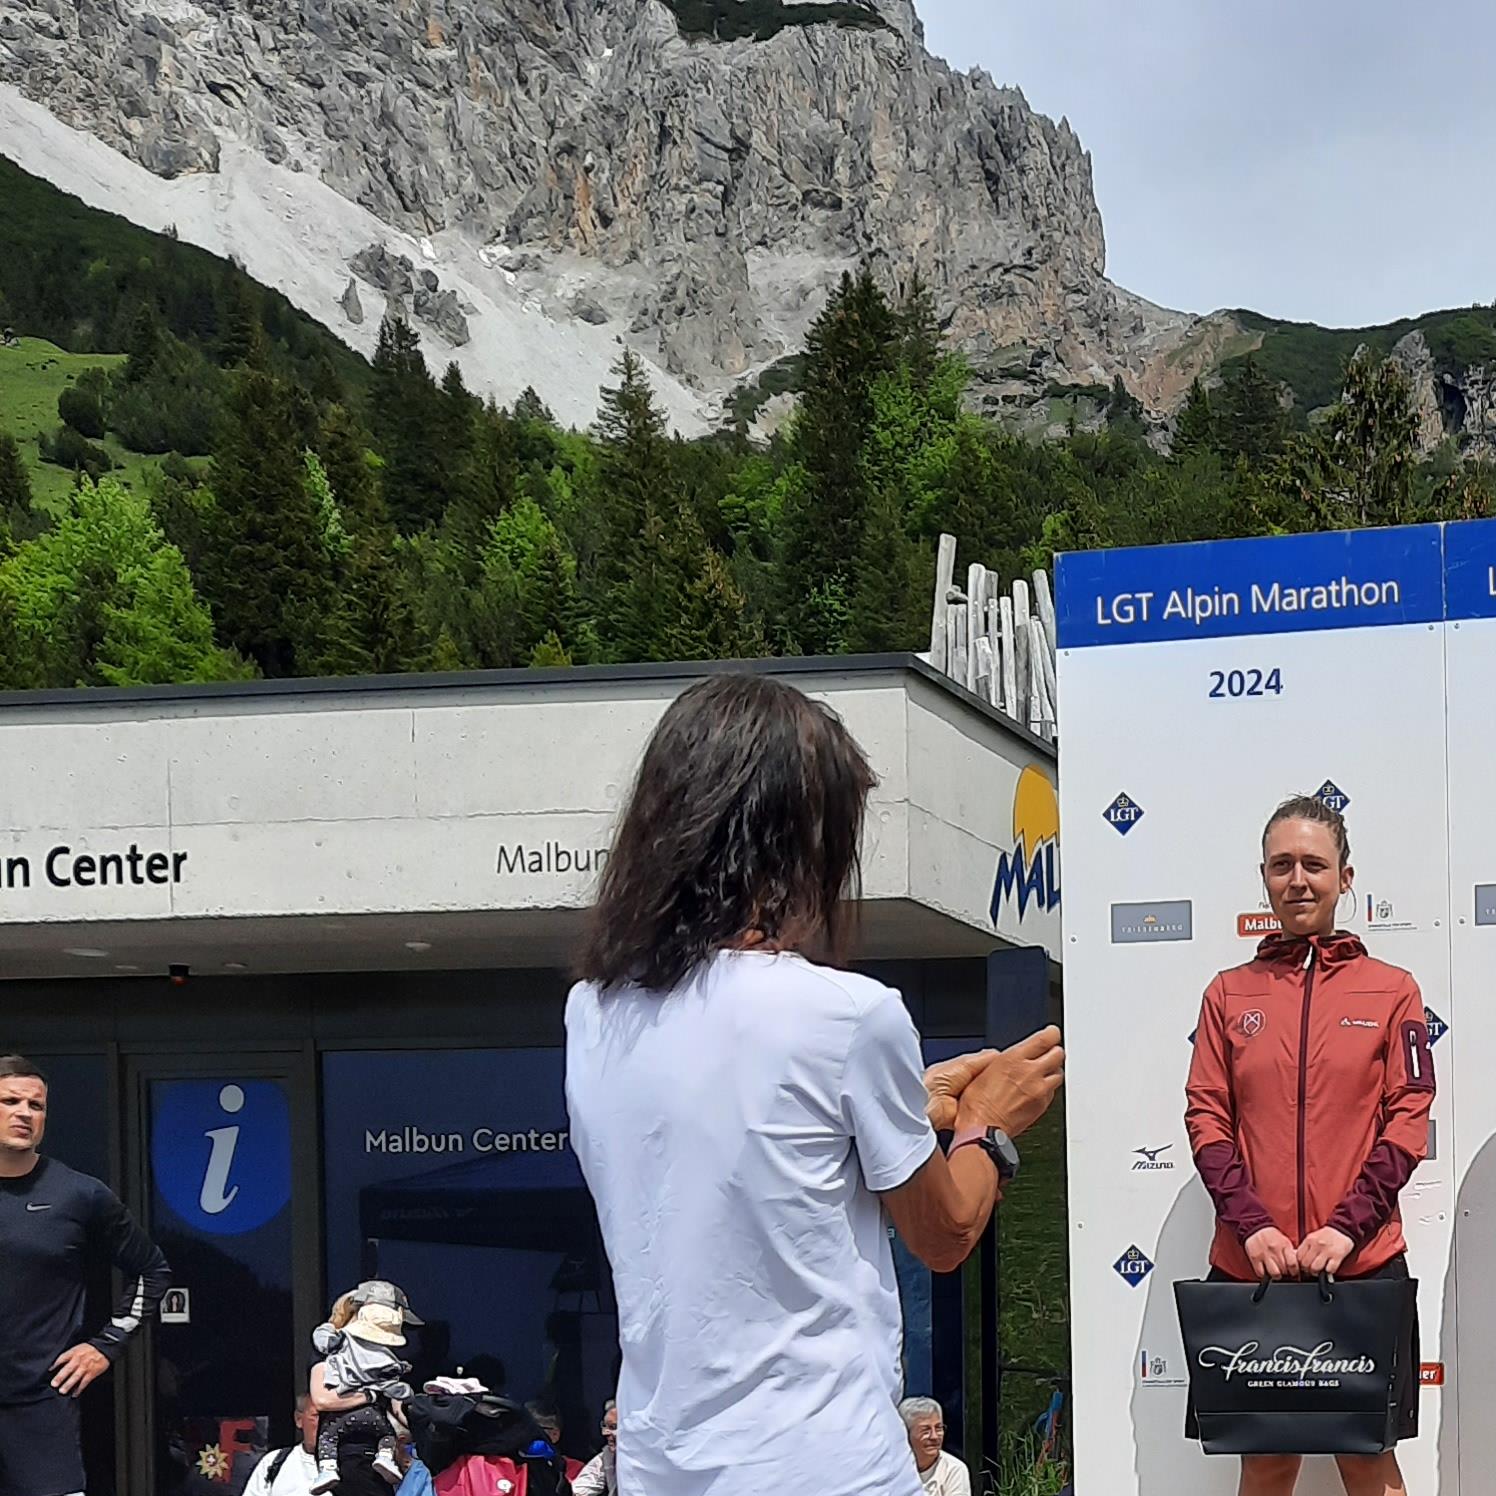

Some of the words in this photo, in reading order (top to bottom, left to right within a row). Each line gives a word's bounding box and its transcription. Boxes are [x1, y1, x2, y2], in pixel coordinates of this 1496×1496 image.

[1096, 592, 1154, 625] LGT
[1162, 586, 1240, 625] Alpin
[1250, 575, 1400, 614] Marathon
[1207, 667, 1284, 698] 2024
[1109, 805, 1141, 823] LGT
[45, 843, 188, 888] Center
[365, 1127, 463, 1153] Malbun
[472, 1128, 568, 1151] Center
[1119, 1259, 1148, 1274] LGT
